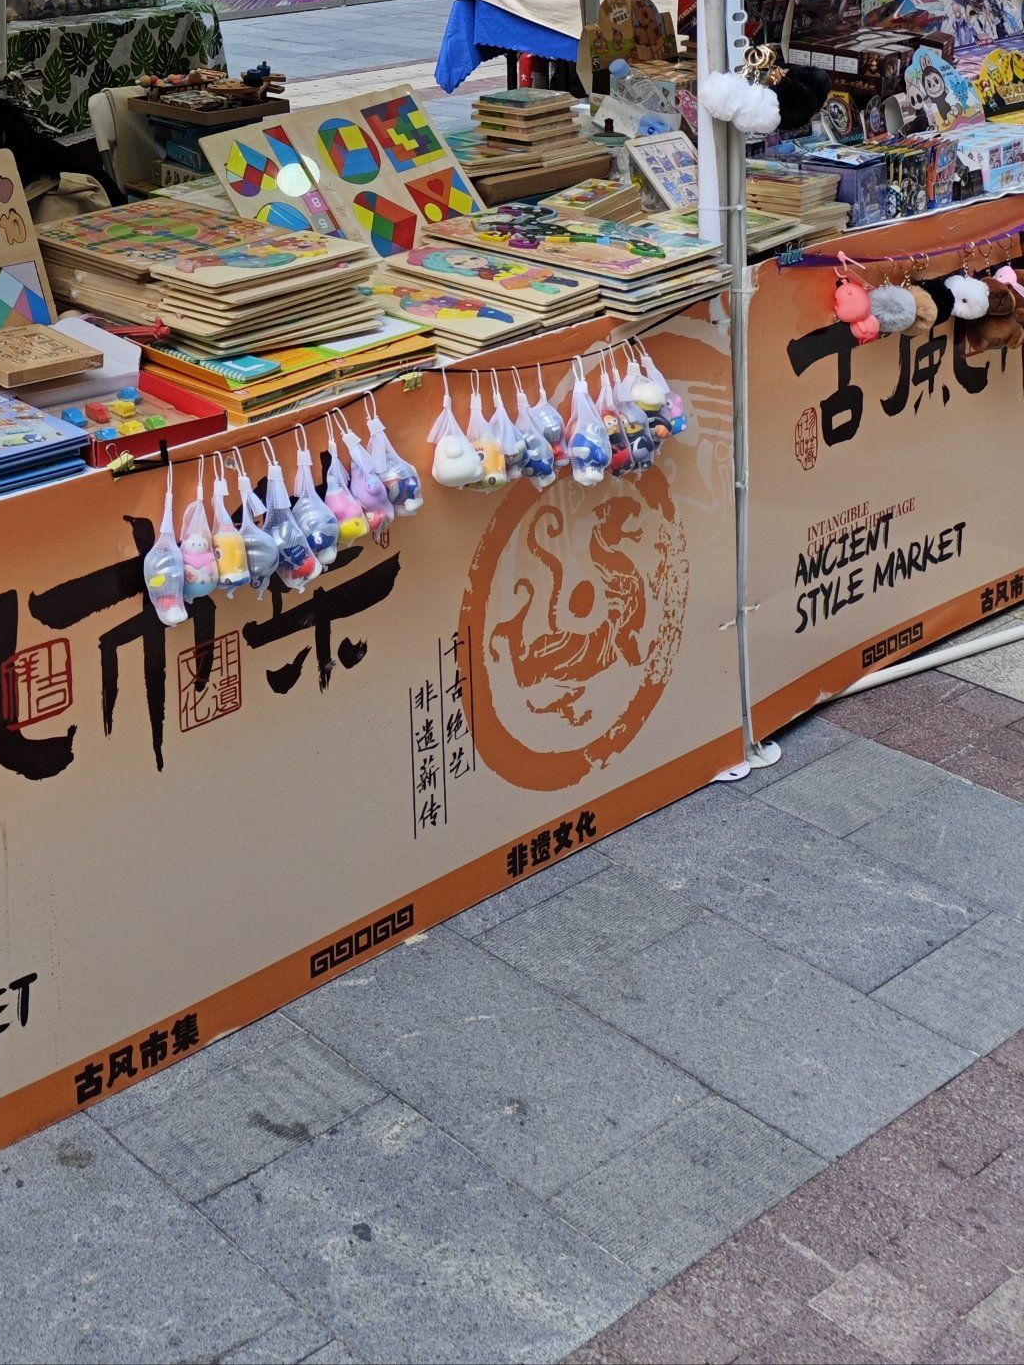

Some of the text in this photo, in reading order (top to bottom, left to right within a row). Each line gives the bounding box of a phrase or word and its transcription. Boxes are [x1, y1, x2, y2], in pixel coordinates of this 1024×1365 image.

[794, 512, 894, 588] ANCIENT
[807, 500, 870, 542] INTANGIBLE
[794, 521, 967, 634] STYLE MARKET
[507, 810, 598, 879] 非遗文化
[74, 1012, 201, 1105] 古风市集
